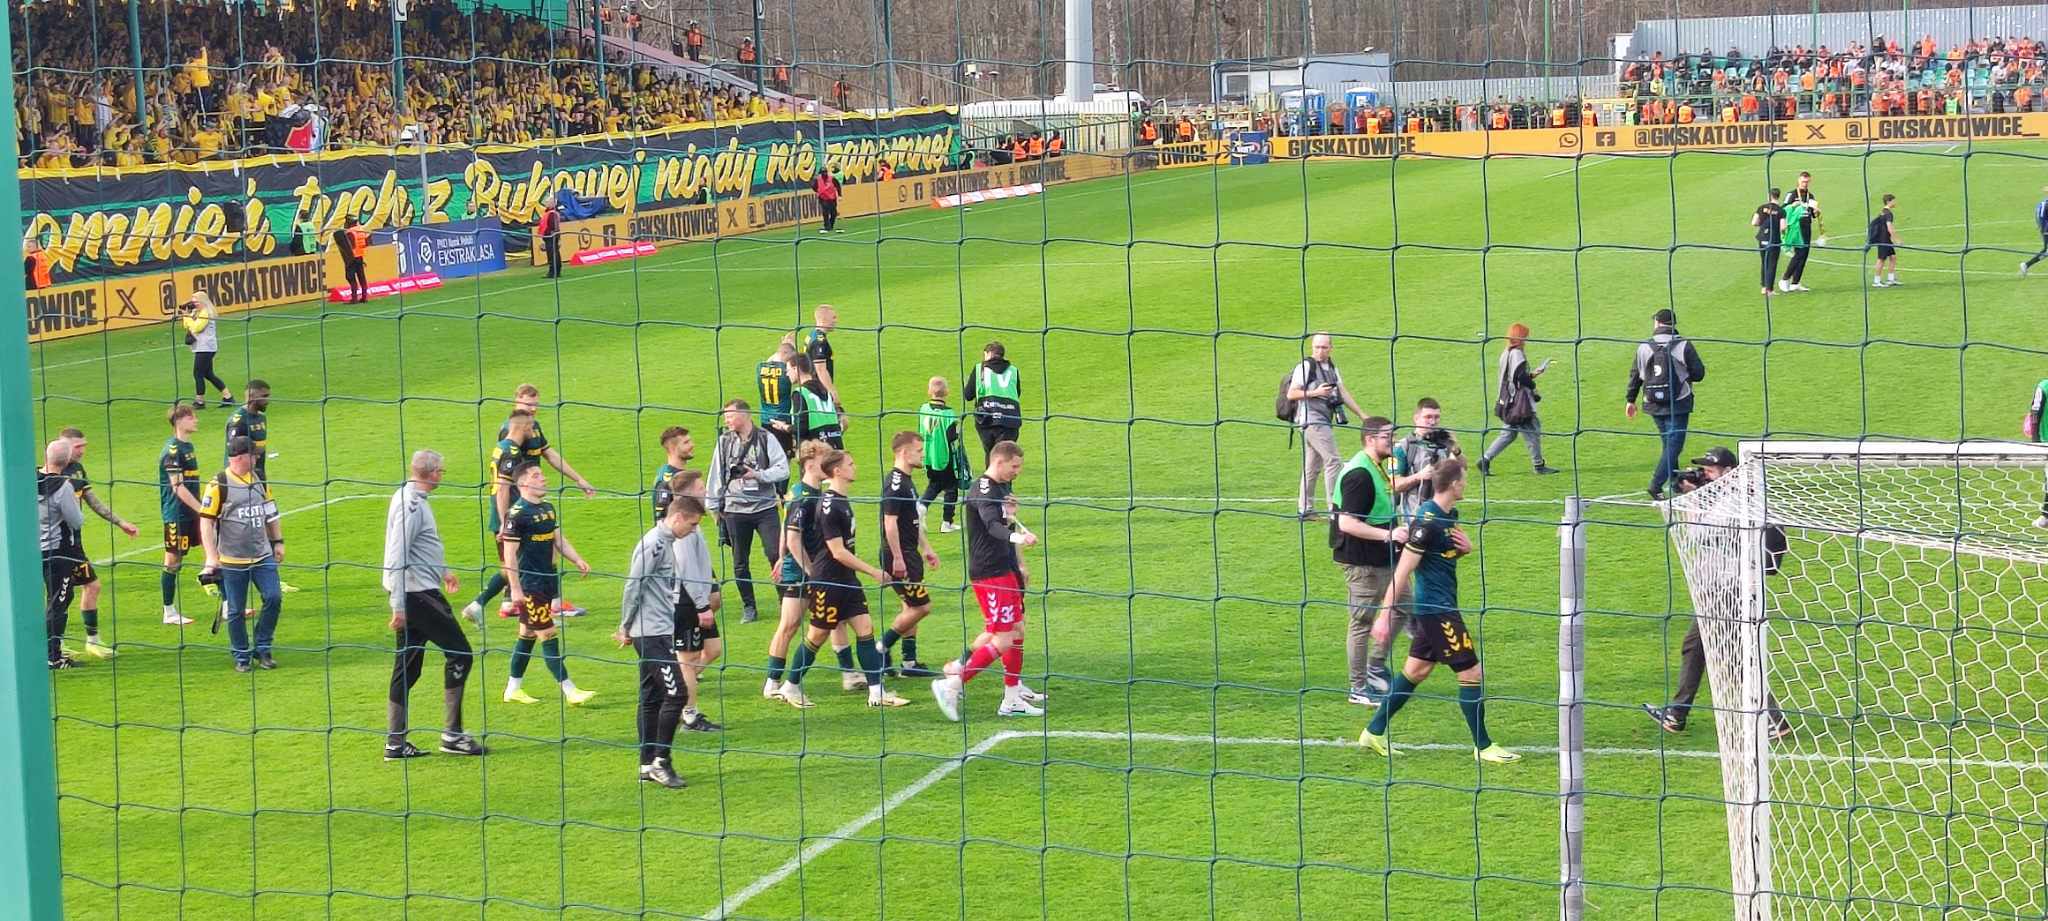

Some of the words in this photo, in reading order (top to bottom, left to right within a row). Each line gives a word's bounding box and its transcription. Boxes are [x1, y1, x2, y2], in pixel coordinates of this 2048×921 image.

[1287, 136, 1417, 158] GKSKATOWICE
[1634, 124, 1788, 147] @GKSKATOWICE
[767, 130, 818, 185] nie
[761, 377, 780, 405] 11
[252, 517, 263, 529] 13
